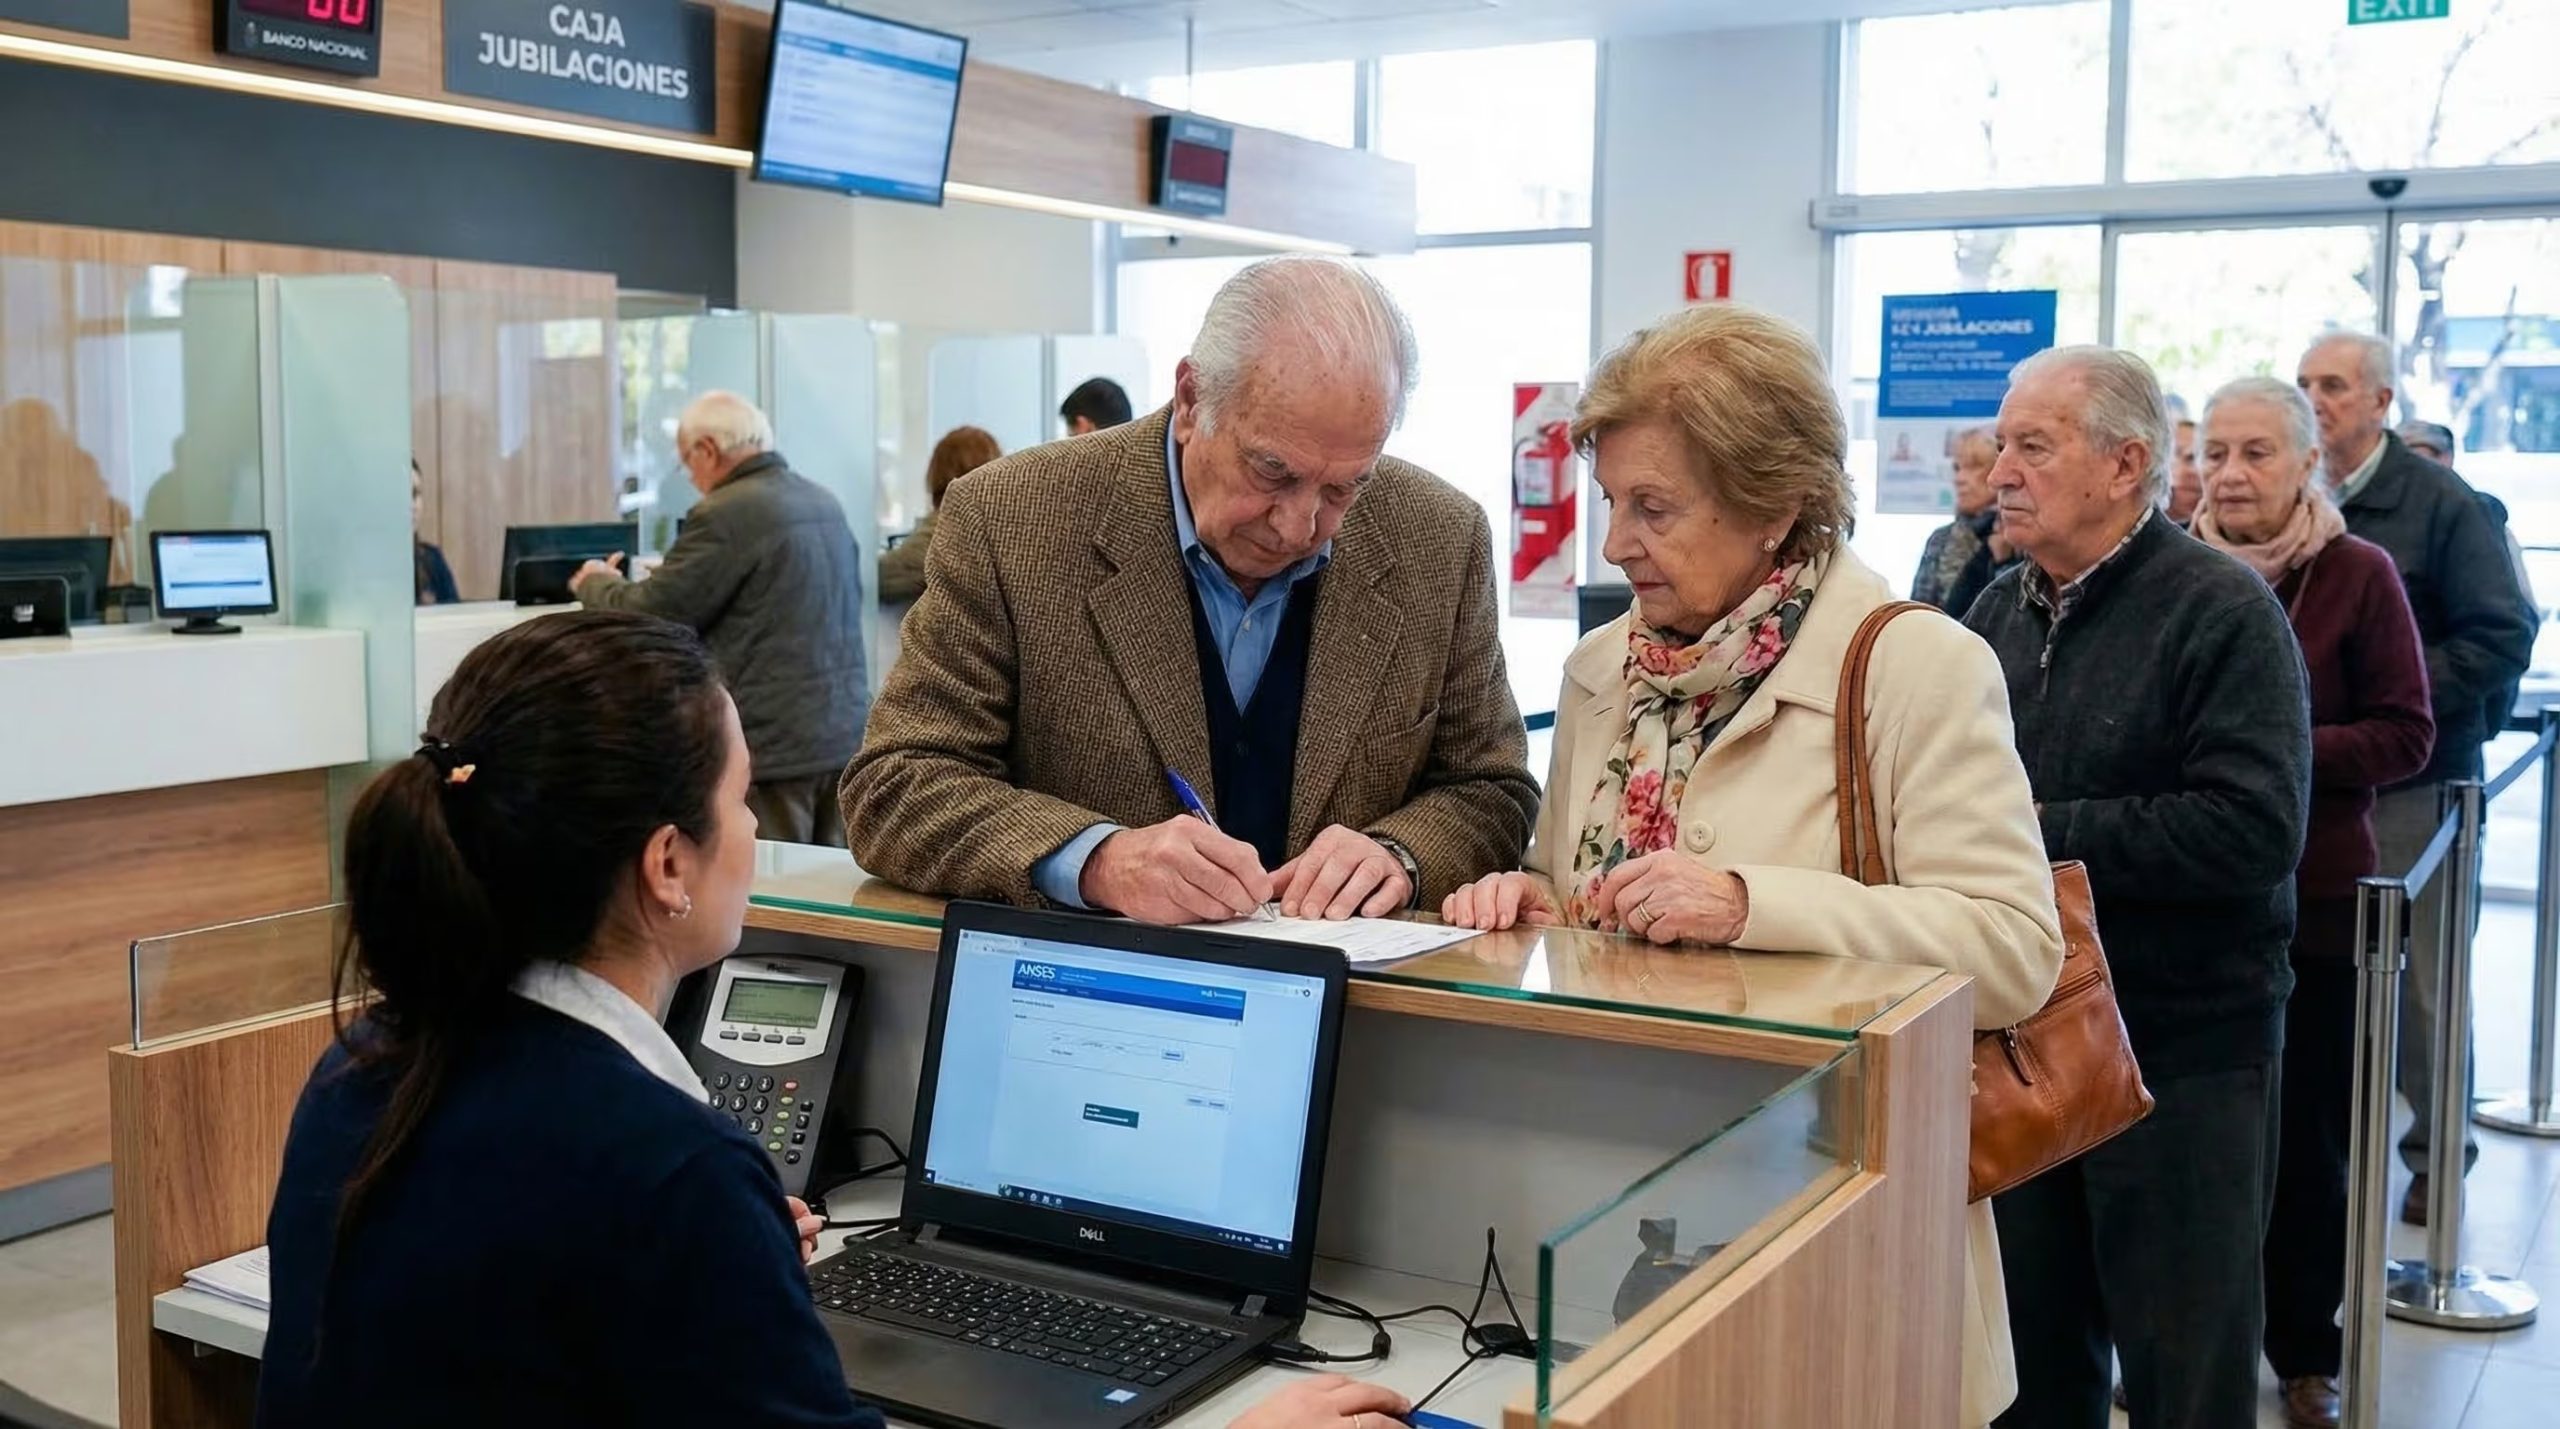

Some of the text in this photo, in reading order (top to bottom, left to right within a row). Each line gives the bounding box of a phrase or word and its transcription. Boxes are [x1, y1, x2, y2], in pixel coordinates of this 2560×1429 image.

[549, 4, 626, 47] CAJA
[262, 30, 368, 60] BANCO NACIONAL
[478, 32, 689, 99] JUBILACIONES
[1017, 963, 1057, 979] ANSES
[1079, 1226, 1106, 1242] DELL
